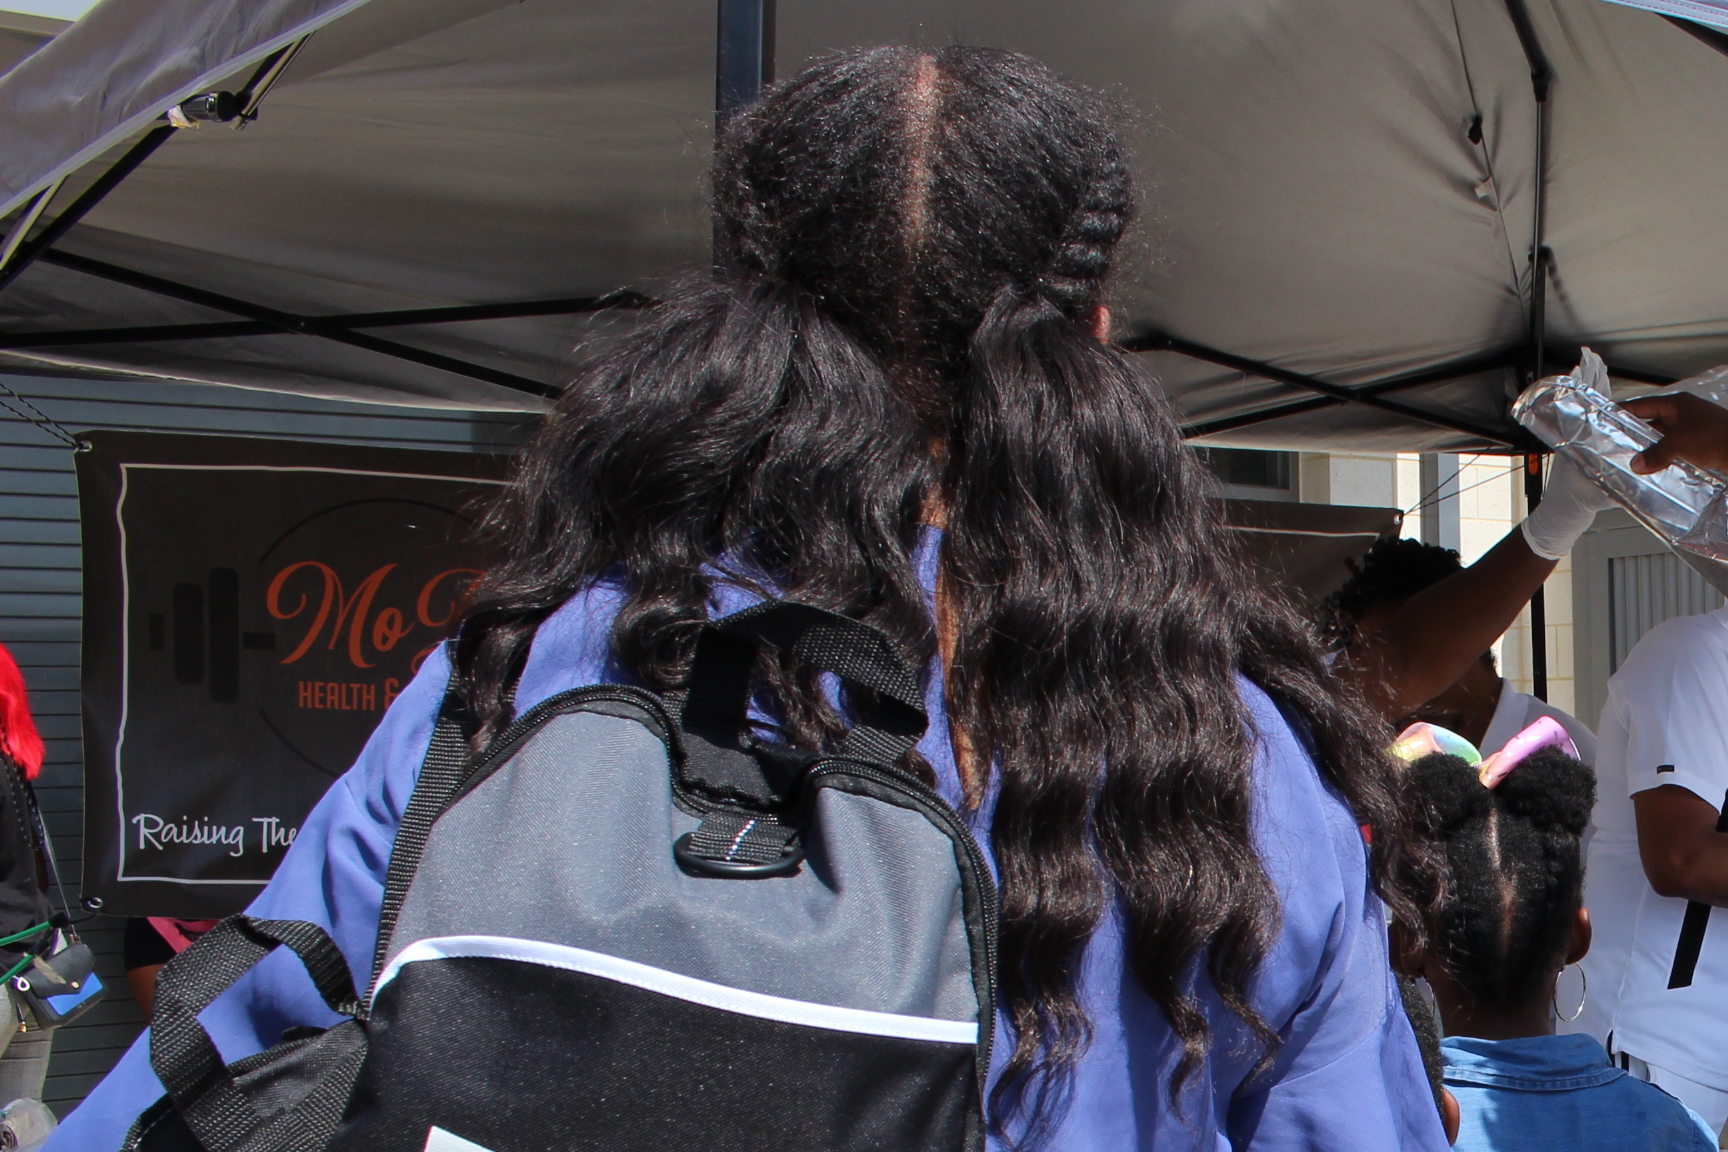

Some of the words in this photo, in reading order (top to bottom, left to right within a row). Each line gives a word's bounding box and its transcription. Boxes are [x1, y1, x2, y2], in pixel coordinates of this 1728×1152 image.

[298, 680, 376, 711] HEALTH
[132, 813, 245, 857] Raising
[252, 816, 298, 853] The
